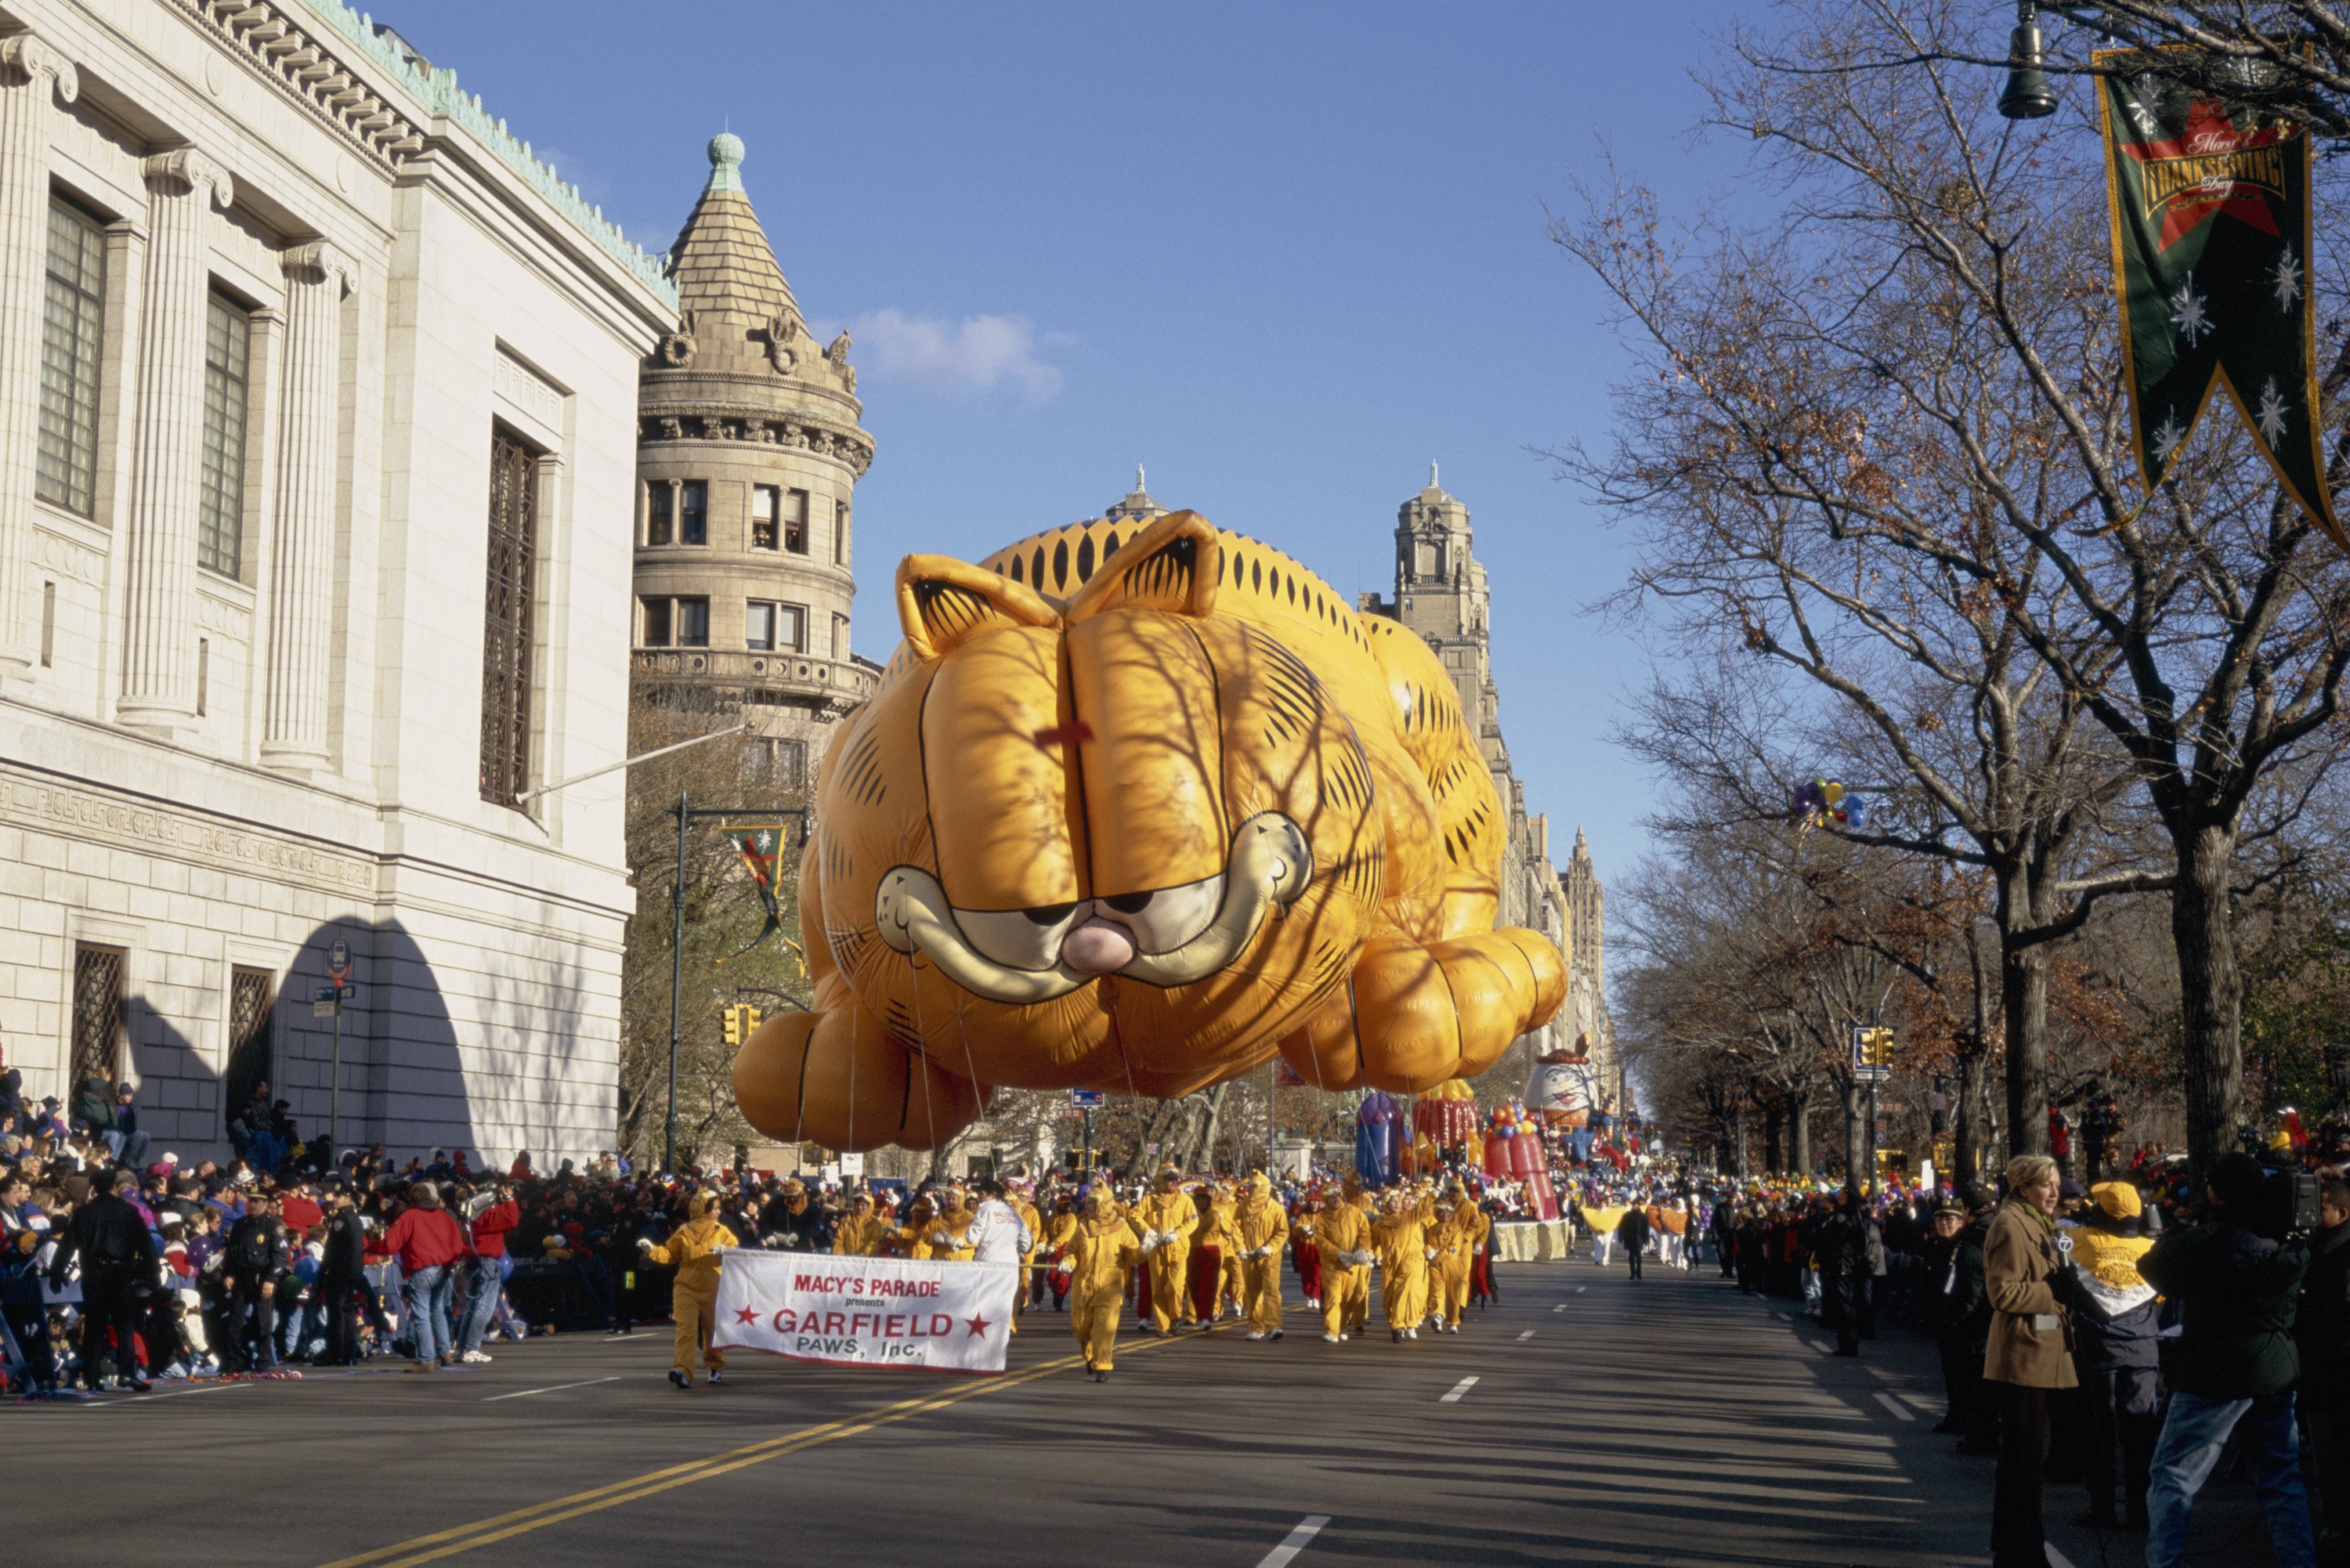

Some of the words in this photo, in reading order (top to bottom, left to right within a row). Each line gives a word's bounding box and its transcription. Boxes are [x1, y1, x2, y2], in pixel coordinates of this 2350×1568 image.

[2201, 173, 2234, 197] Day
[2059, 1237, 2073, 1252] 7
[794, 1274, 865, 1295] MACY'S
[870, 1279, 941, 1297] PARADE
[845, 1298, 885, 1307] presents
[773, 1309, 953, 1337] GARFIELD
[797, 1337, 865, 1358] PAWS,
[881, 1342, 922, 1357] Inc.
